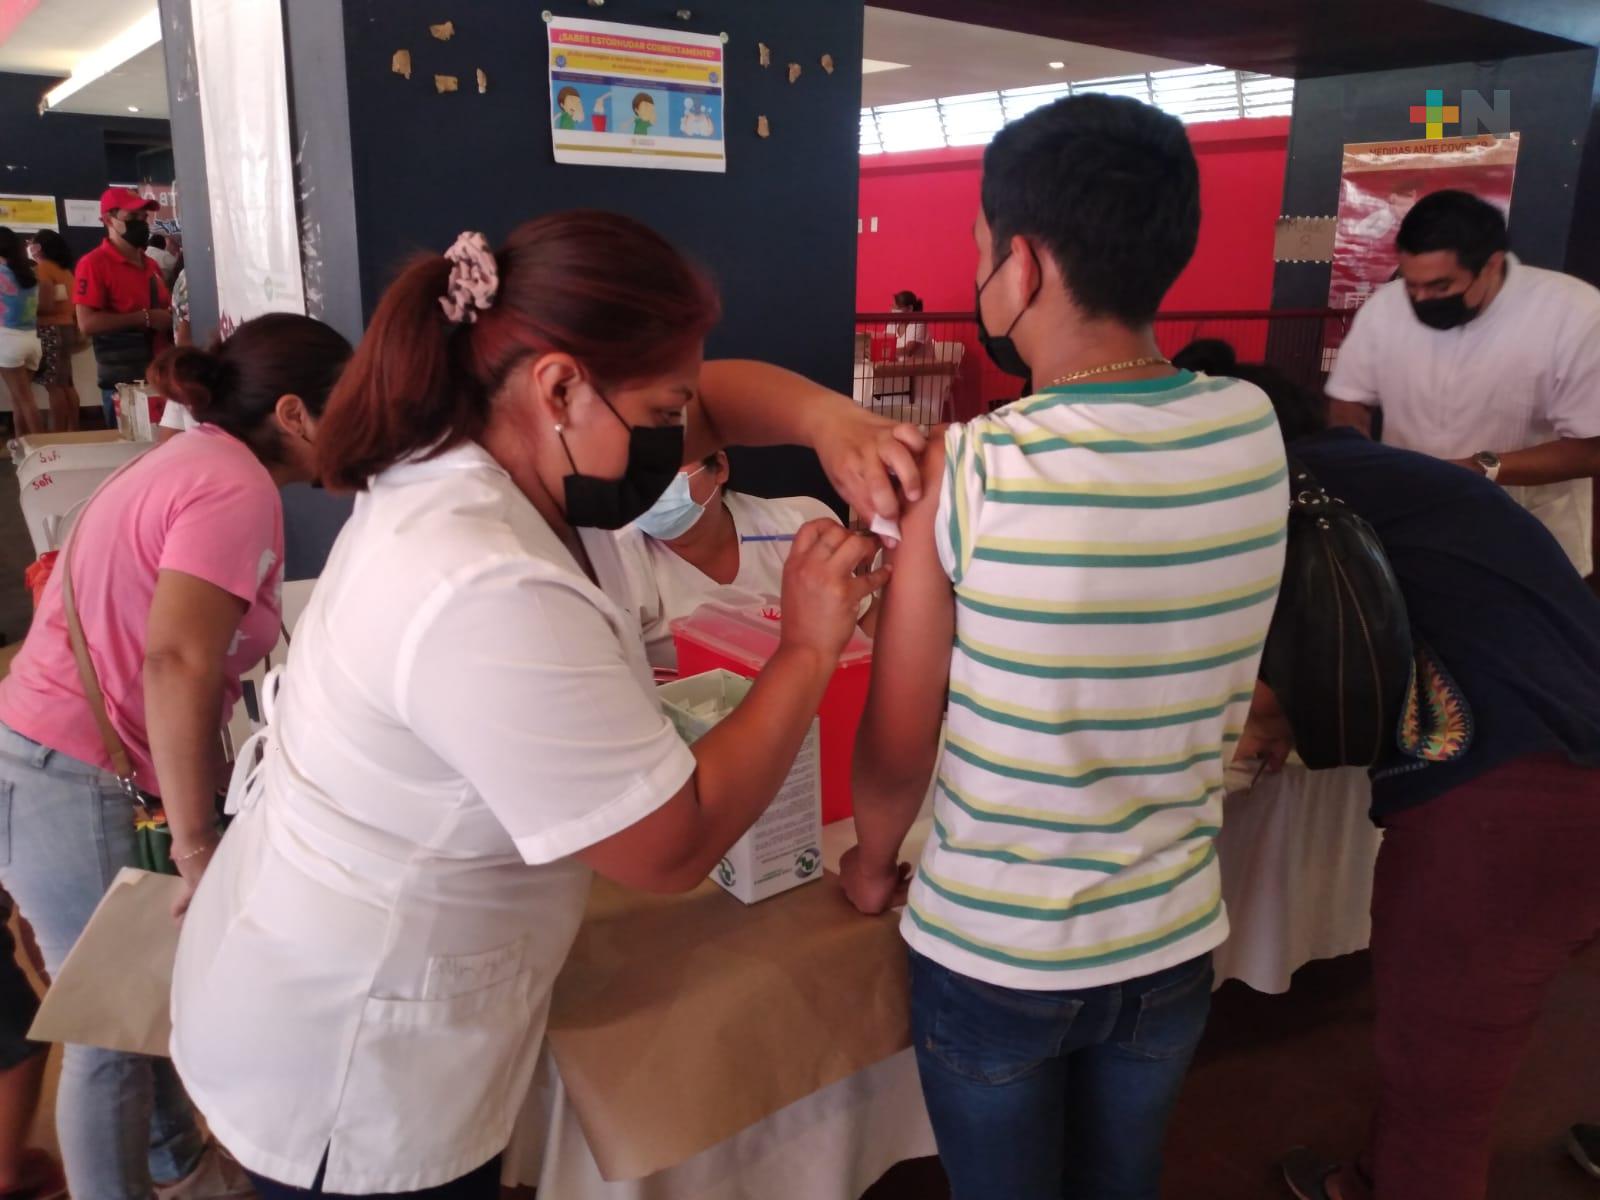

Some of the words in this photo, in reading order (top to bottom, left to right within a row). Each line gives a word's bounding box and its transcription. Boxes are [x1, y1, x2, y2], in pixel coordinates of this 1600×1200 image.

[1369, 146, 1411, 156] MEDIDAS
[1413, 144, 1438, 154] ANTE
[77, 278, 88, 295] 3
